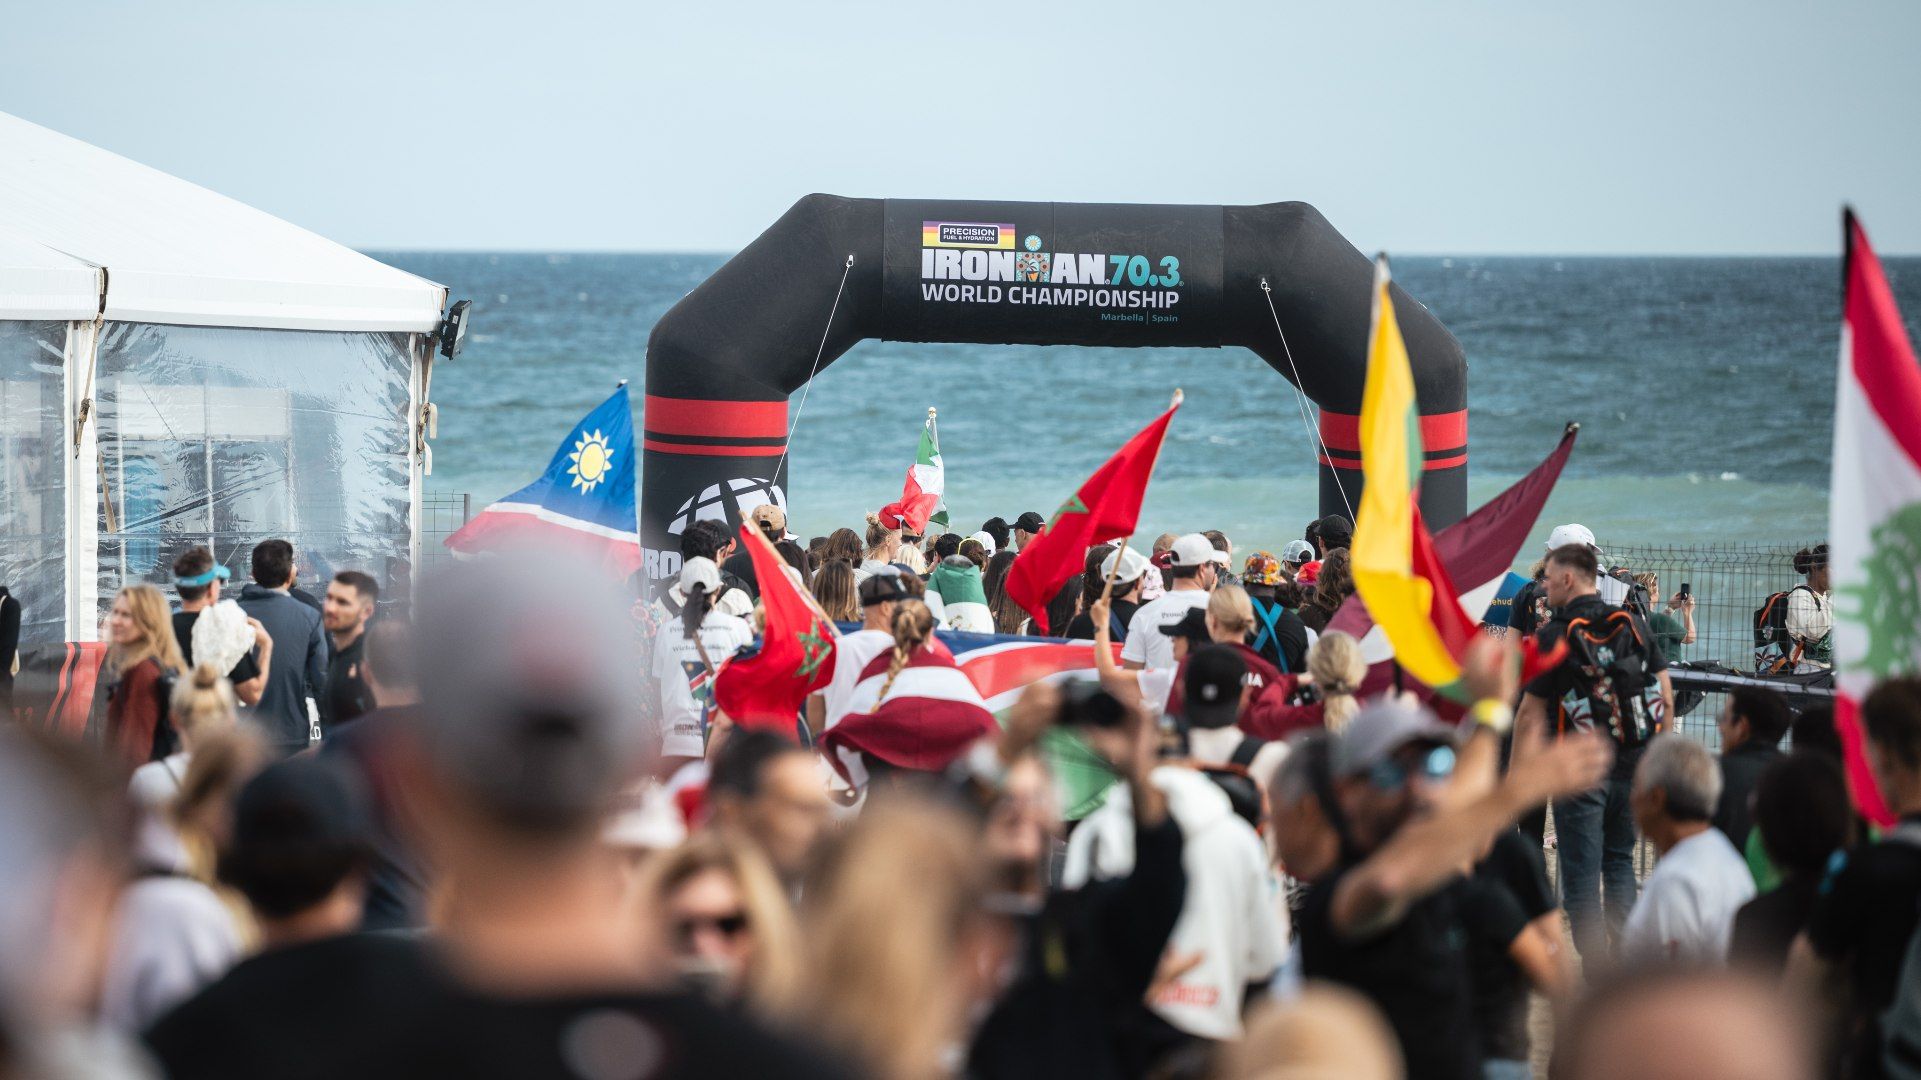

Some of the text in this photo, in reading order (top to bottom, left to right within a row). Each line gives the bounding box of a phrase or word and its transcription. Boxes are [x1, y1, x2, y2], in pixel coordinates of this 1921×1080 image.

[943, 227, 995, 236] PRECISION
[1109, 254, 1182, 288] 70.3
[921, 283, 1180, 309] WORLD CHAMPIONSHIP
[1101, 313, 1178, 323] Marbella Spain
